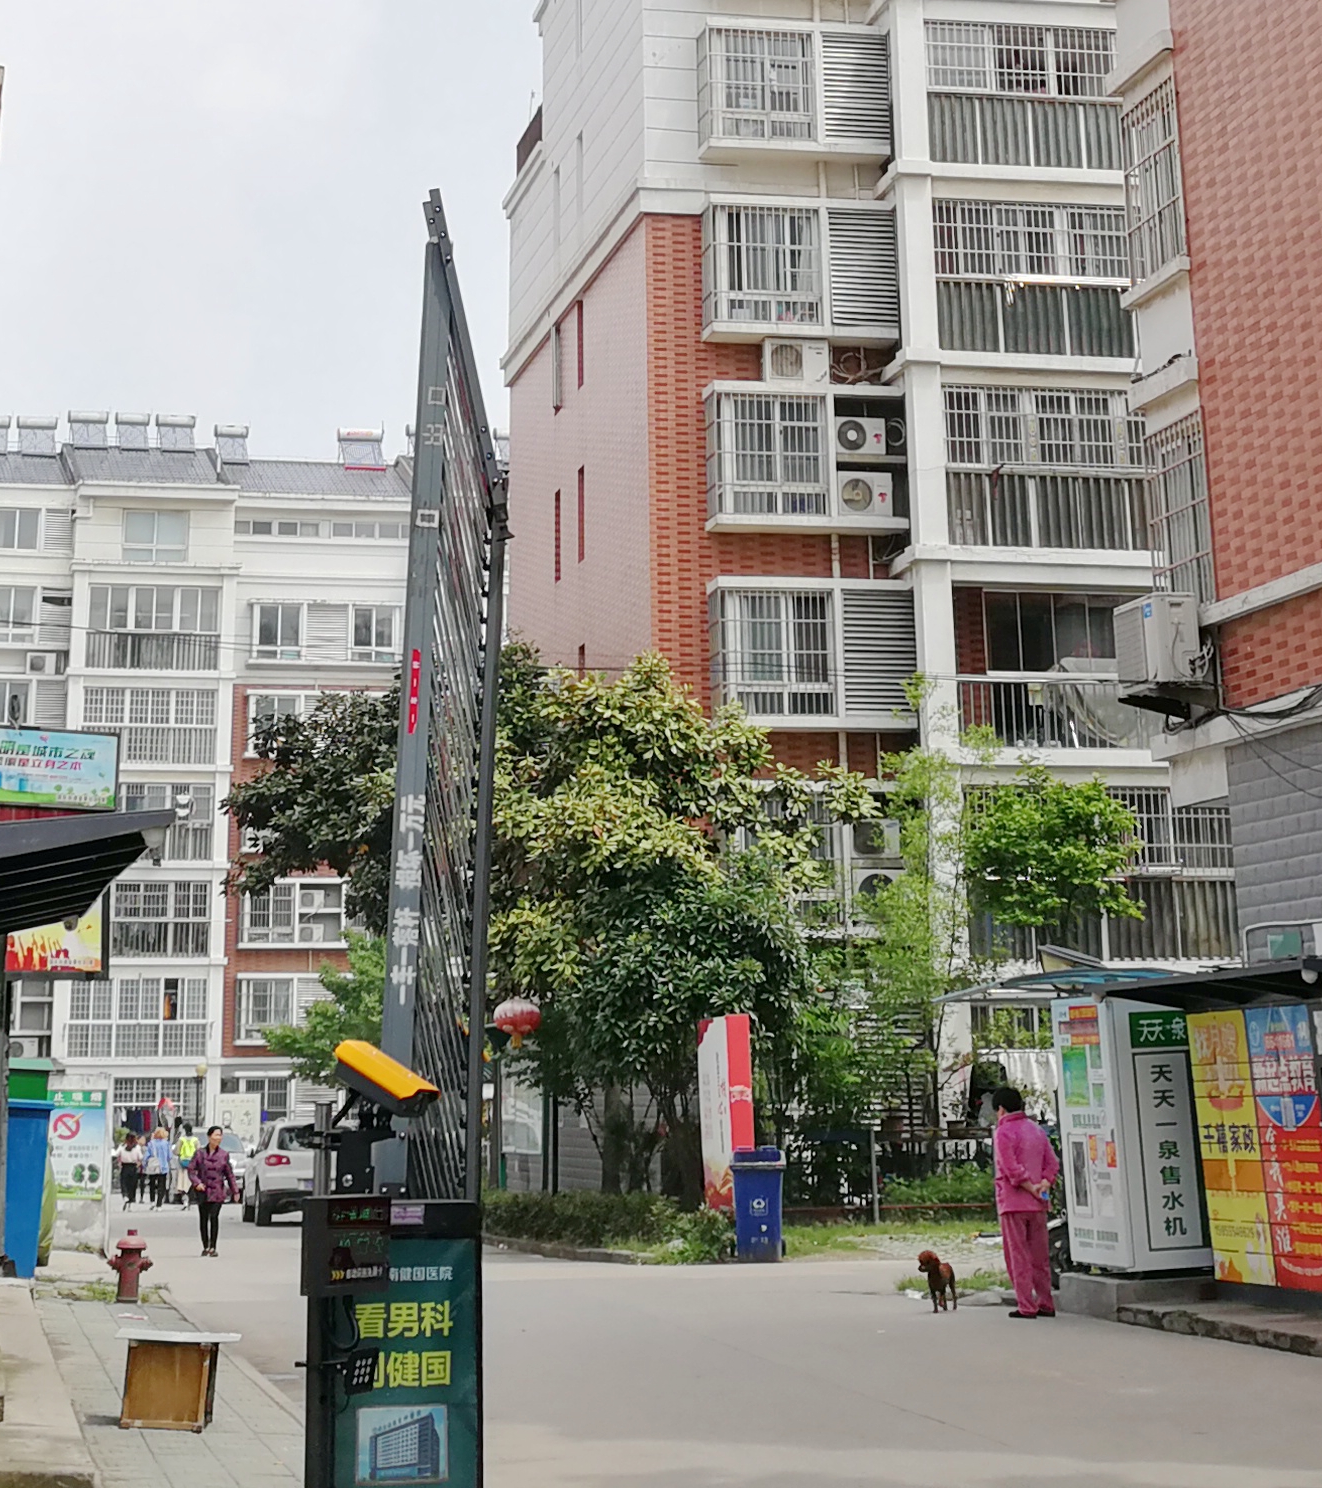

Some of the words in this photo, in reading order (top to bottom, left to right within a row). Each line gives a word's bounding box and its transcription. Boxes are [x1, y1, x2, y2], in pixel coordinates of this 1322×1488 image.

[1150, 1064, 1188, 1237] 天天一泉售水机
[1203, 1122, 1256, 1154] 千禧家政
[355, 1300, 453, 1339] 看男科
